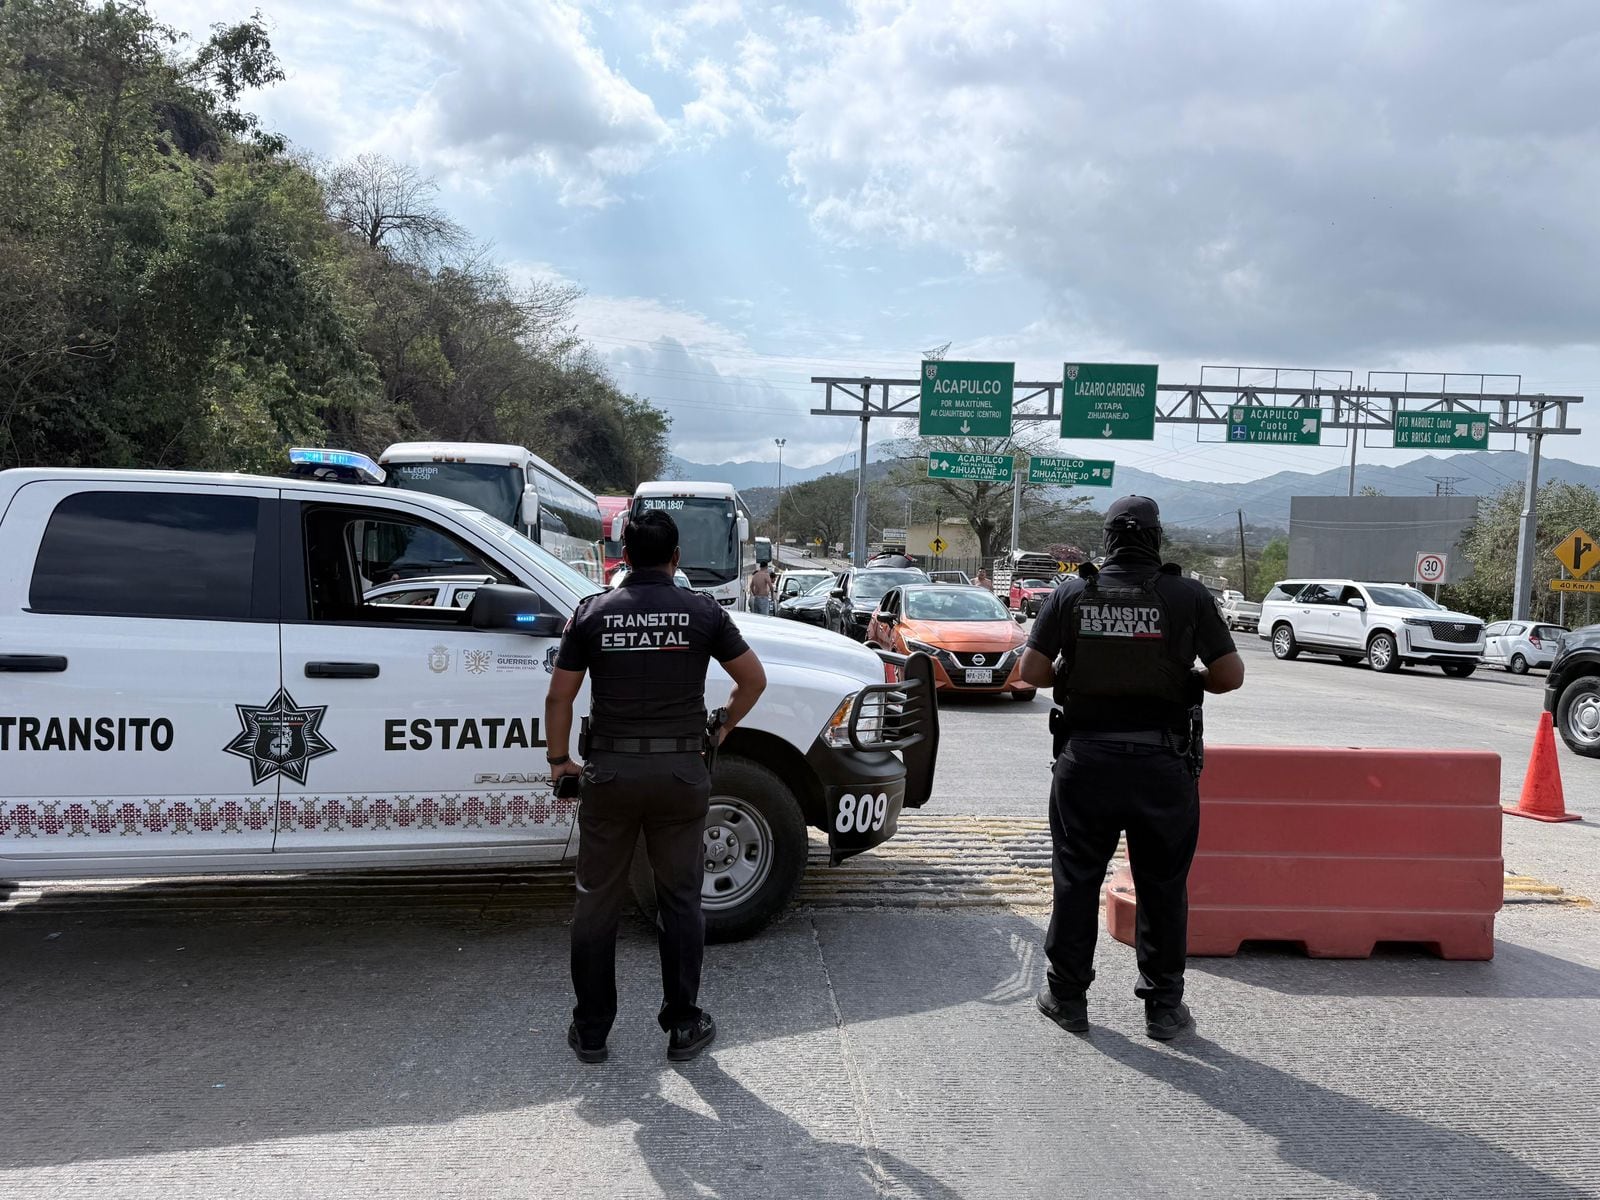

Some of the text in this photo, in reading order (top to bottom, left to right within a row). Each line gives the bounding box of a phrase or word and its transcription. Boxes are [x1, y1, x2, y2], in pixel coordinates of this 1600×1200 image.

[934, 380, 1001, 394] ACAPULCO
[1075, 382, 1145, 397] LAZARO CARDENAS
[1088, 412, 1129, 420] ZIHUATANEJO
[1250, 410, 1299, 419] ACAPULCO
[1399, 417, 1408, 427] PTO
[1411, 417, 1434, 427] MARQUEZ
[1250, 431, 1297, 441] V DIAMANTE
[1398, 432, 1408, 442] LAS
[1412, 432, 1431, 443] BRISAS
[957, 455, 1003, 463] ACAPULCO
[1040, 459, 1084, 467] HUATULCO
[951, 466, 1008, 476] ZIHUATANEJO
[1032, 470, 1089, 480] ZIHUATANEJO
[644, 500, 666, 510] SALIDA
[1424, 560, 1438, 572] 30
[1080, 604, 1160, 622] TRÁNSITO
[603, 613, 690, 628] TRANSITO
[1081, 619, 1161, 633] ESTATAL
[601, 632, 690, 647] ESTATAL
[0, 717, 174, 751] TRANSITO
[385, 717, 548, 751] ESTATAL
[475, 773, 552, 784] RAM
[836, 792, 888, 833] 809
